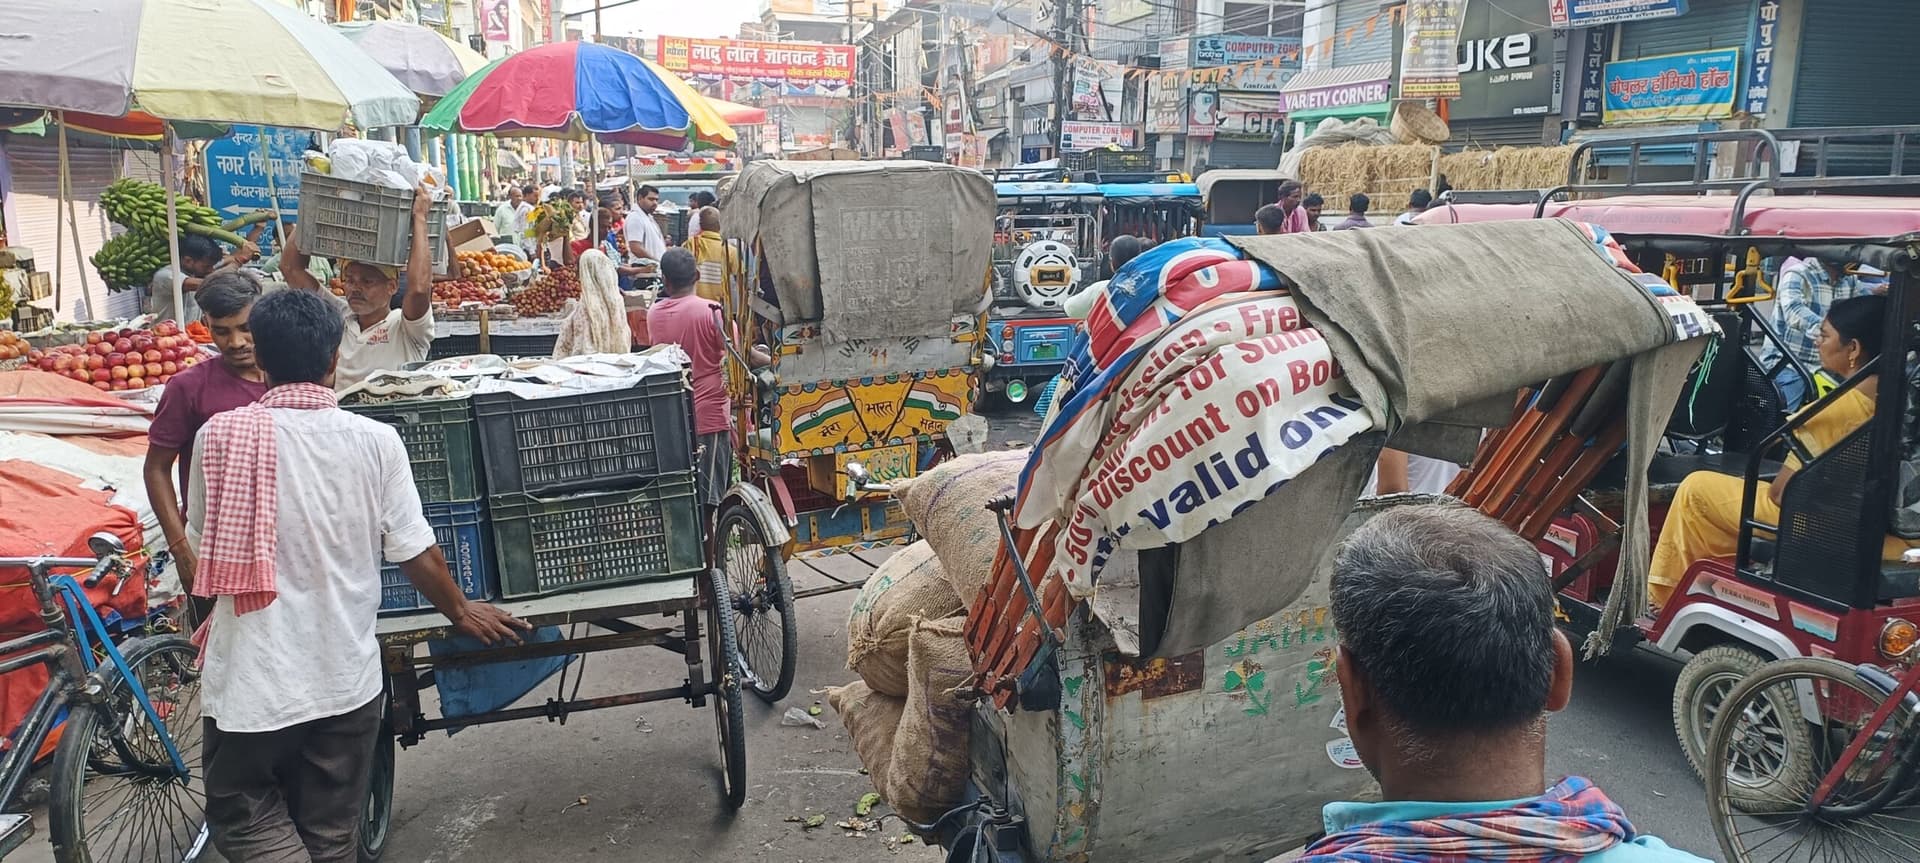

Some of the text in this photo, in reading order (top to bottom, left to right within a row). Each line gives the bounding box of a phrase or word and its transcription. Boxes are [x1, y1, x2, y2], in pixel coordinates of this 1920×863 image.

[1225, 41, 1300, 55] COMPUTER ZONE
[1285, 84, 1384, 110] VARIETY CORNER
[1102, 126, 1120, 134] ZONE
[216, 155, 245, 175] नगर
[1236, 378, 1280, 418] on
[865, 400, 896, 418] भारत
[819, 421, 842, 438] मेरा
[1138, 431, 1270, 530] valid
[1721, 586, 1771, 609] TERRA MOTORS
